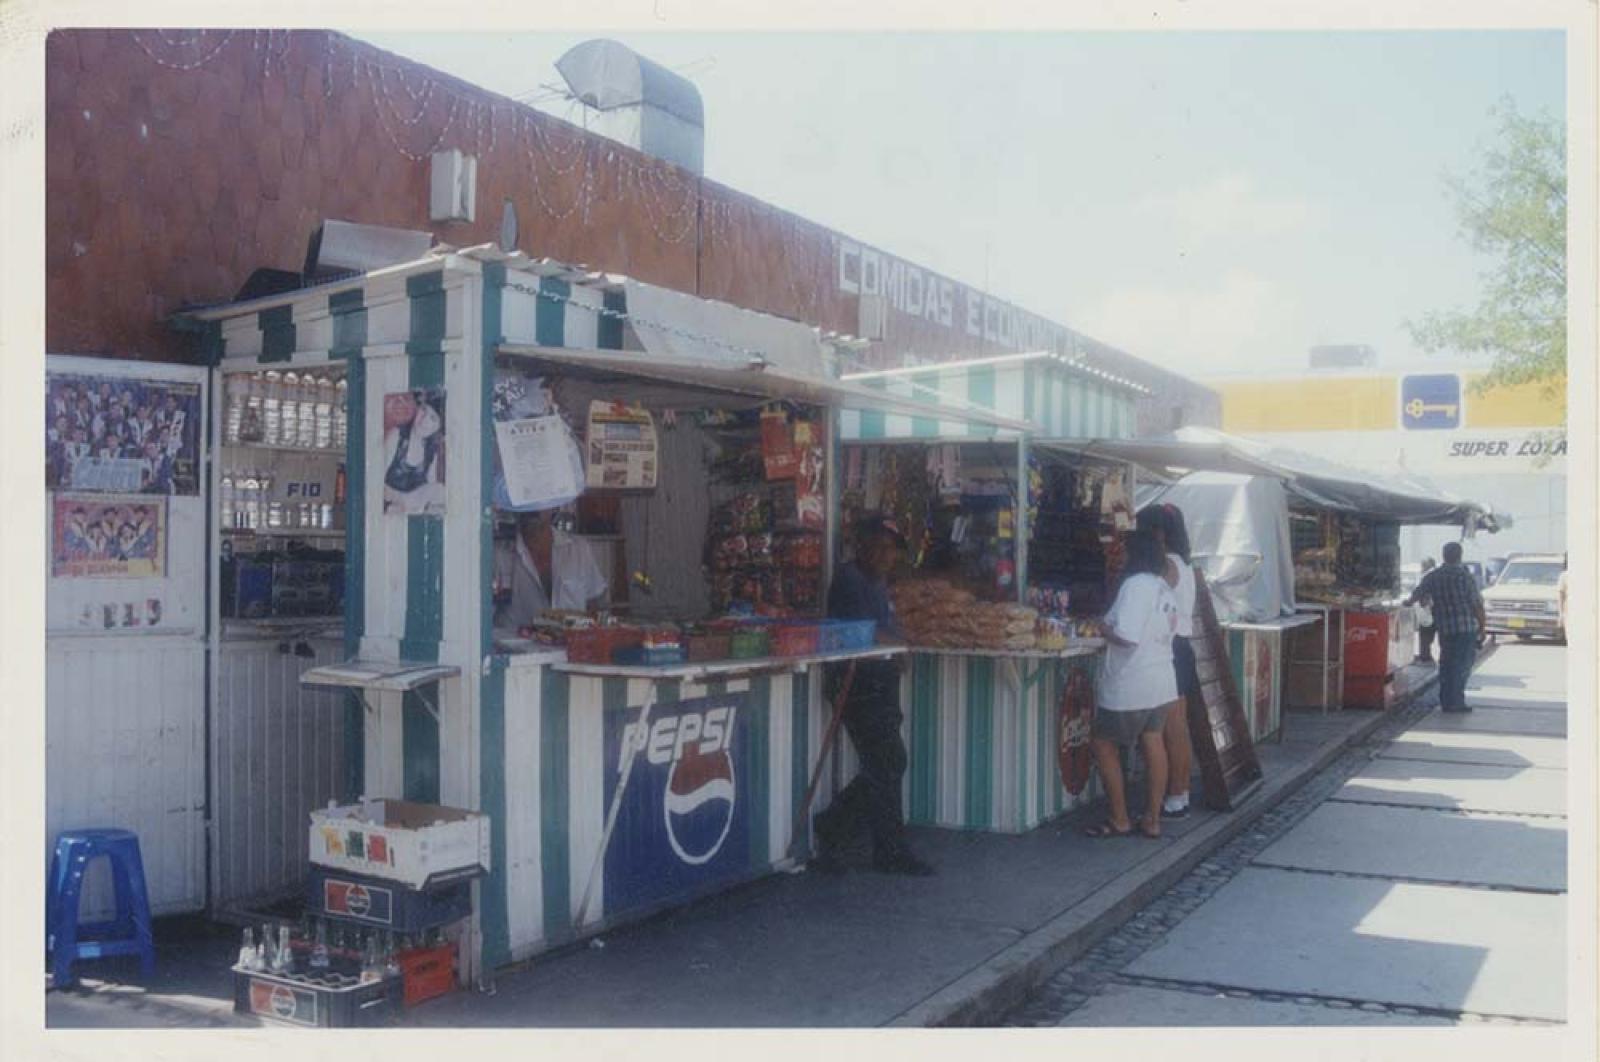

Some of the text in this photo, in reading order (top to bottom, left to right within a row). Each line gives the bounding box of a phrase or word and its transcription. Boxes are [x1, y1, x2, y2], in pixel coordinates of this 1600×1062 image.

[838, 239, 954, 328] COMIDAS
[1449, 440, 1510, 457] SUPER
[617, 706, 737, 774] PEPSI
